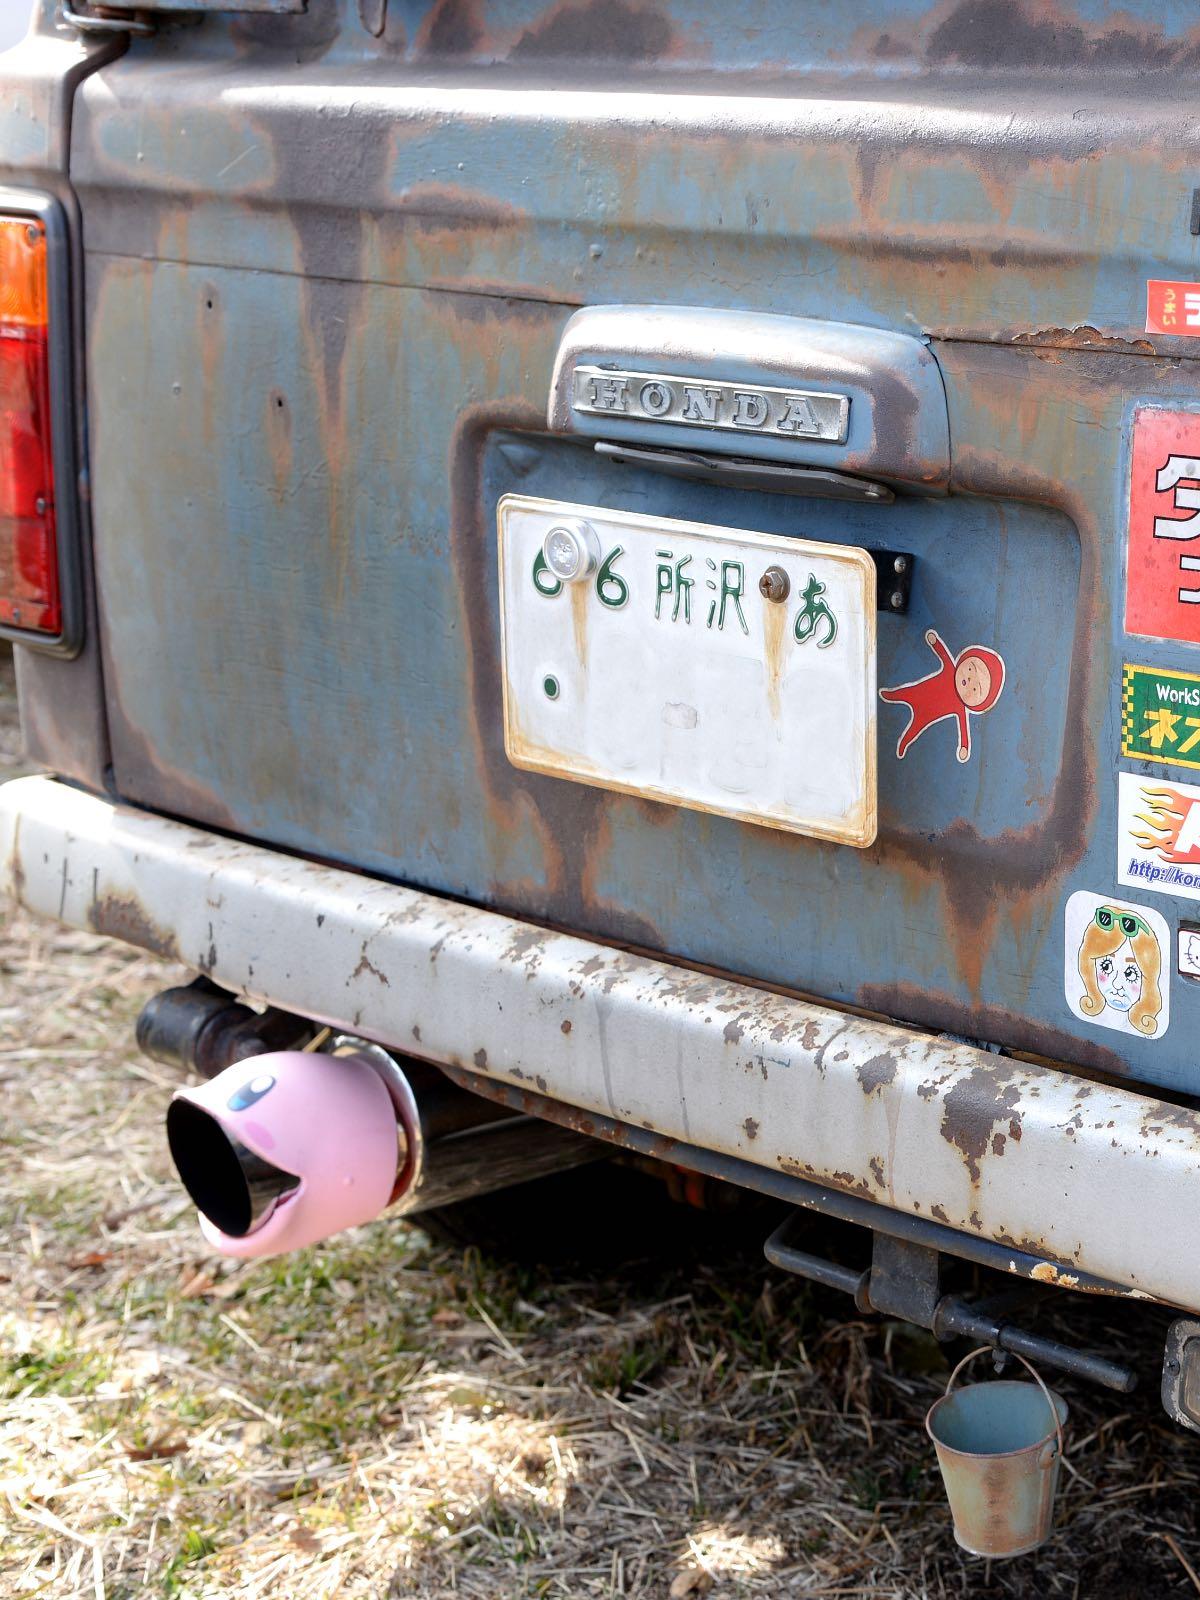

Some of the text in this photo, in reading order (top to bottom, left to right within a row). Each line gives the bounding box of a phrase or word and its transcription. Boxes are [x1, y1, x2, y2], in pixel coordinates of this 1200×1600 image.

[590, 376, 823, 434] HONDA
[655, 549, 750, 636] 所沢
[793, 572, 838, 649] あ
